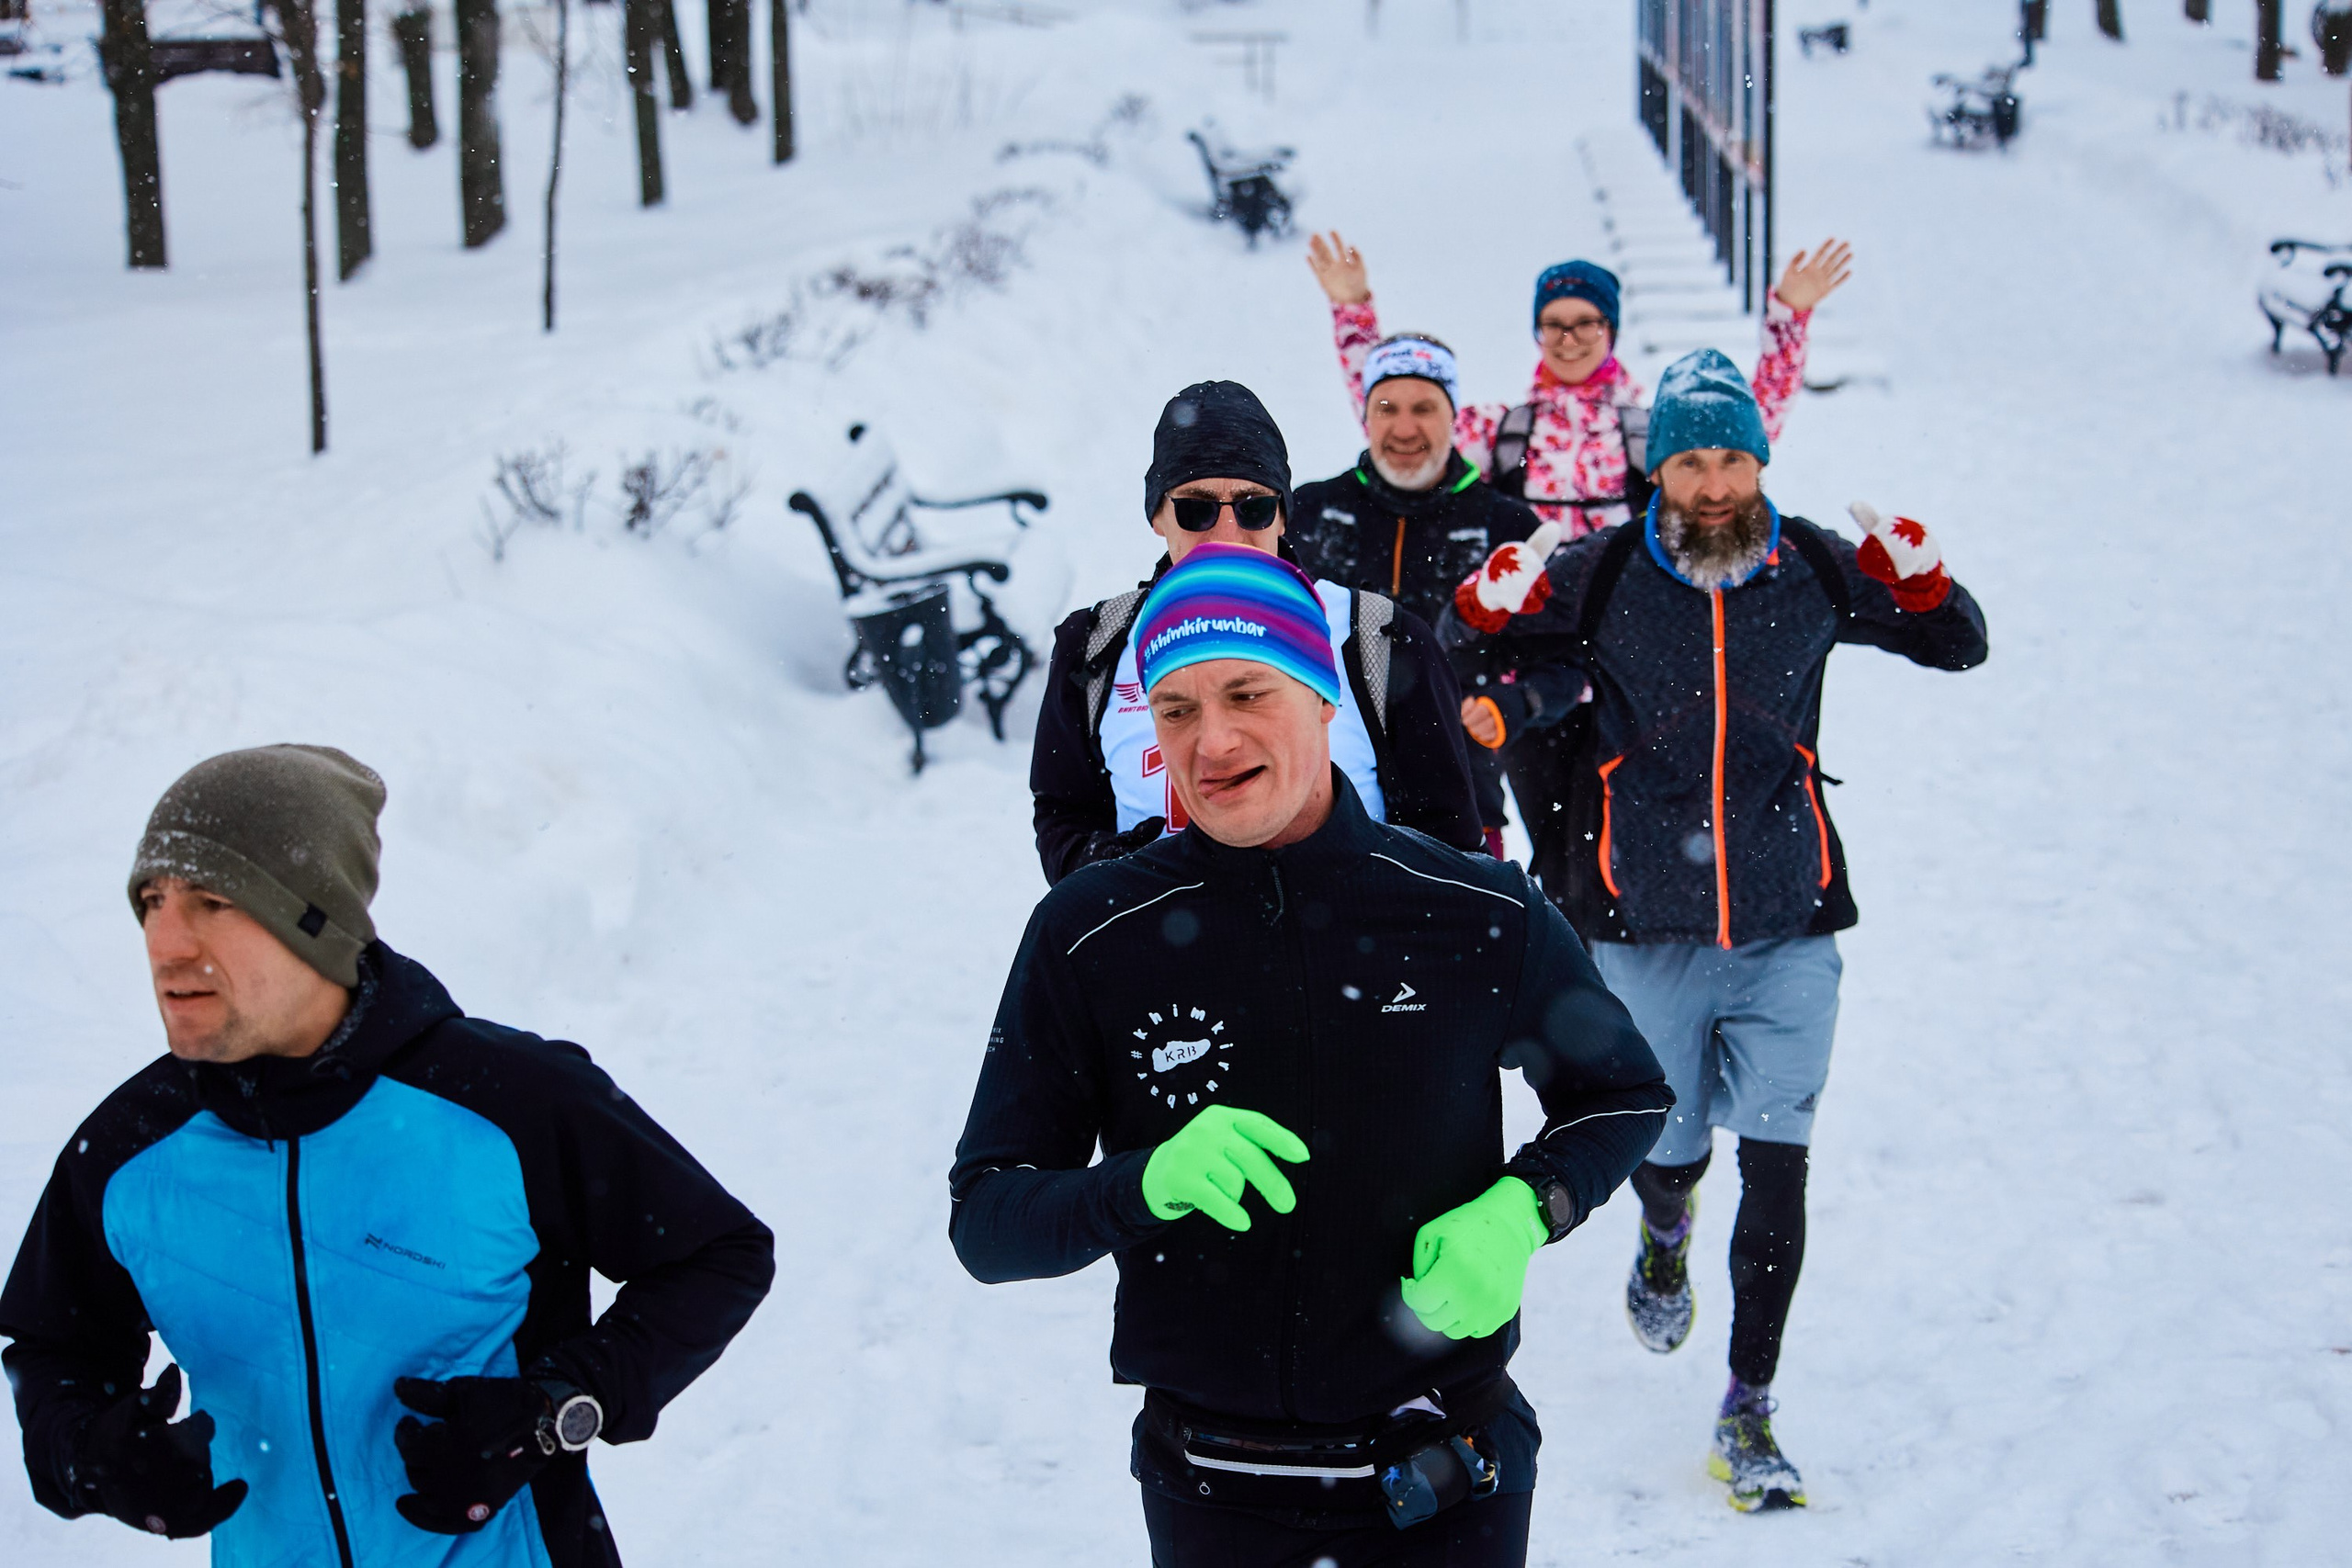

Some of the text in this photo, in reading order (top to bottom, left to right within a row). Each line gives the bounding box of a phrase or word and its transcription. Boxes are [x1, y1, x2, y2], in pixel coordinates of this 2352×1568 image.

[1144, 616, 1267, 663] #khimkirunbar
[1381, 1003, 1426, 1012] DEMIX
[1165, 1045, 1197, 1063] KRB
[383, 1242, 447, 1269] NORDSKI
